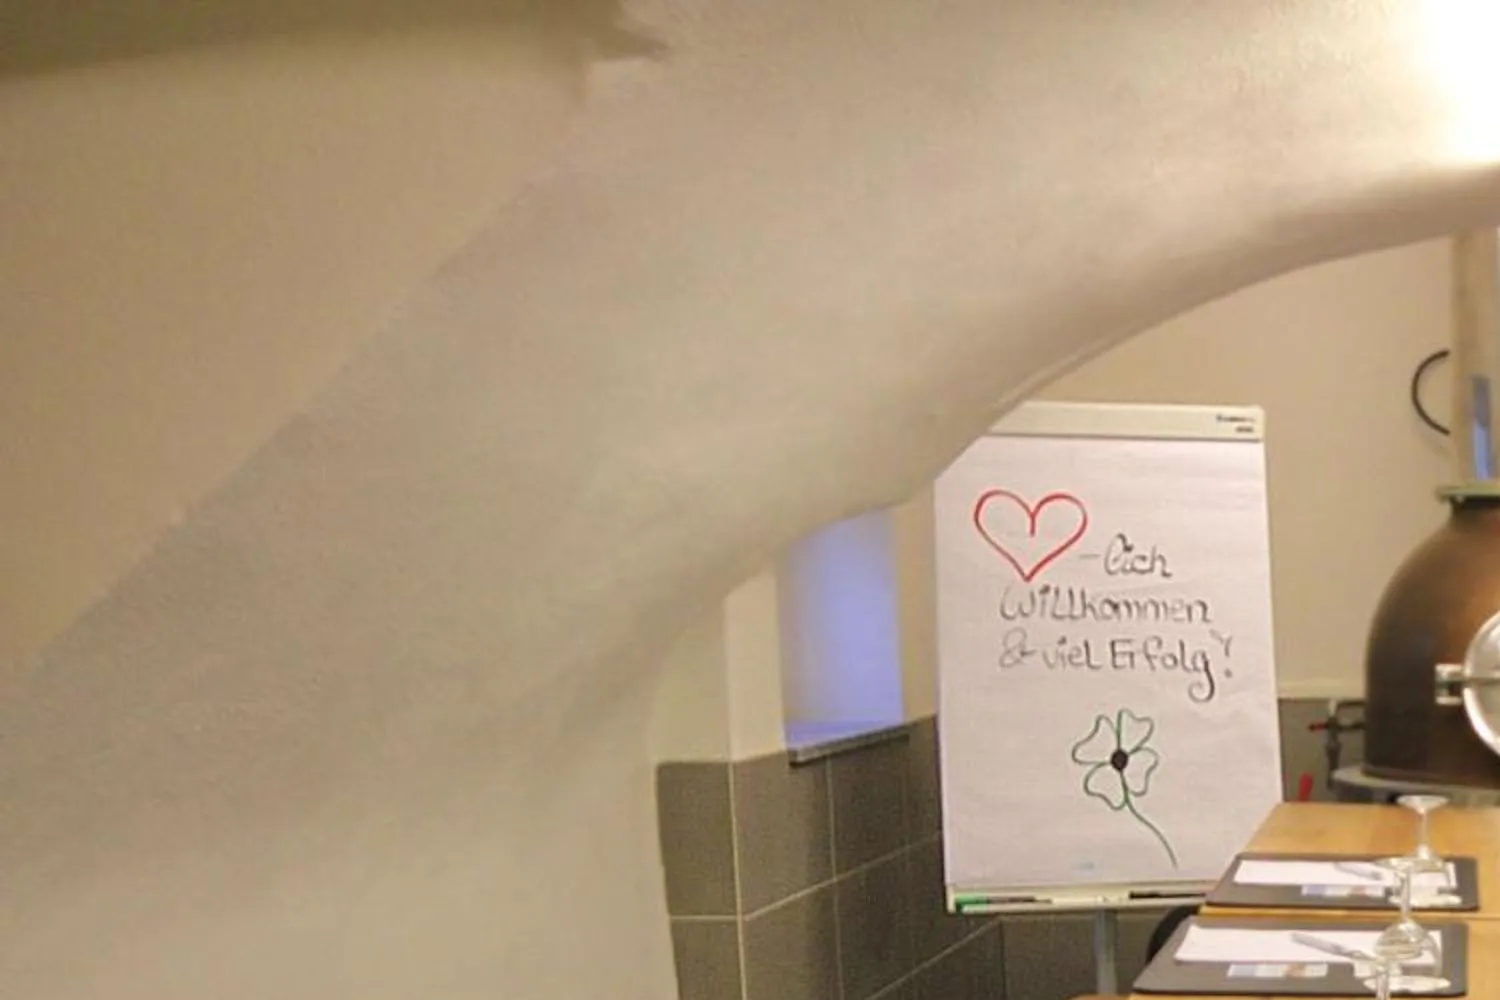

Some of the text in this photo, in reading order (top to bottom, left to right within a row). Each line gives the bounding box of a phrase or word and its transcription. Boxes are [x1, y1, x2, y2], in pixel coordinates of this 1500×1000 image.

[999, 584, 1211, 623] Willkommen
[999, 627, 1036, 669] &
[1042, 635, 1102, 671] viel
